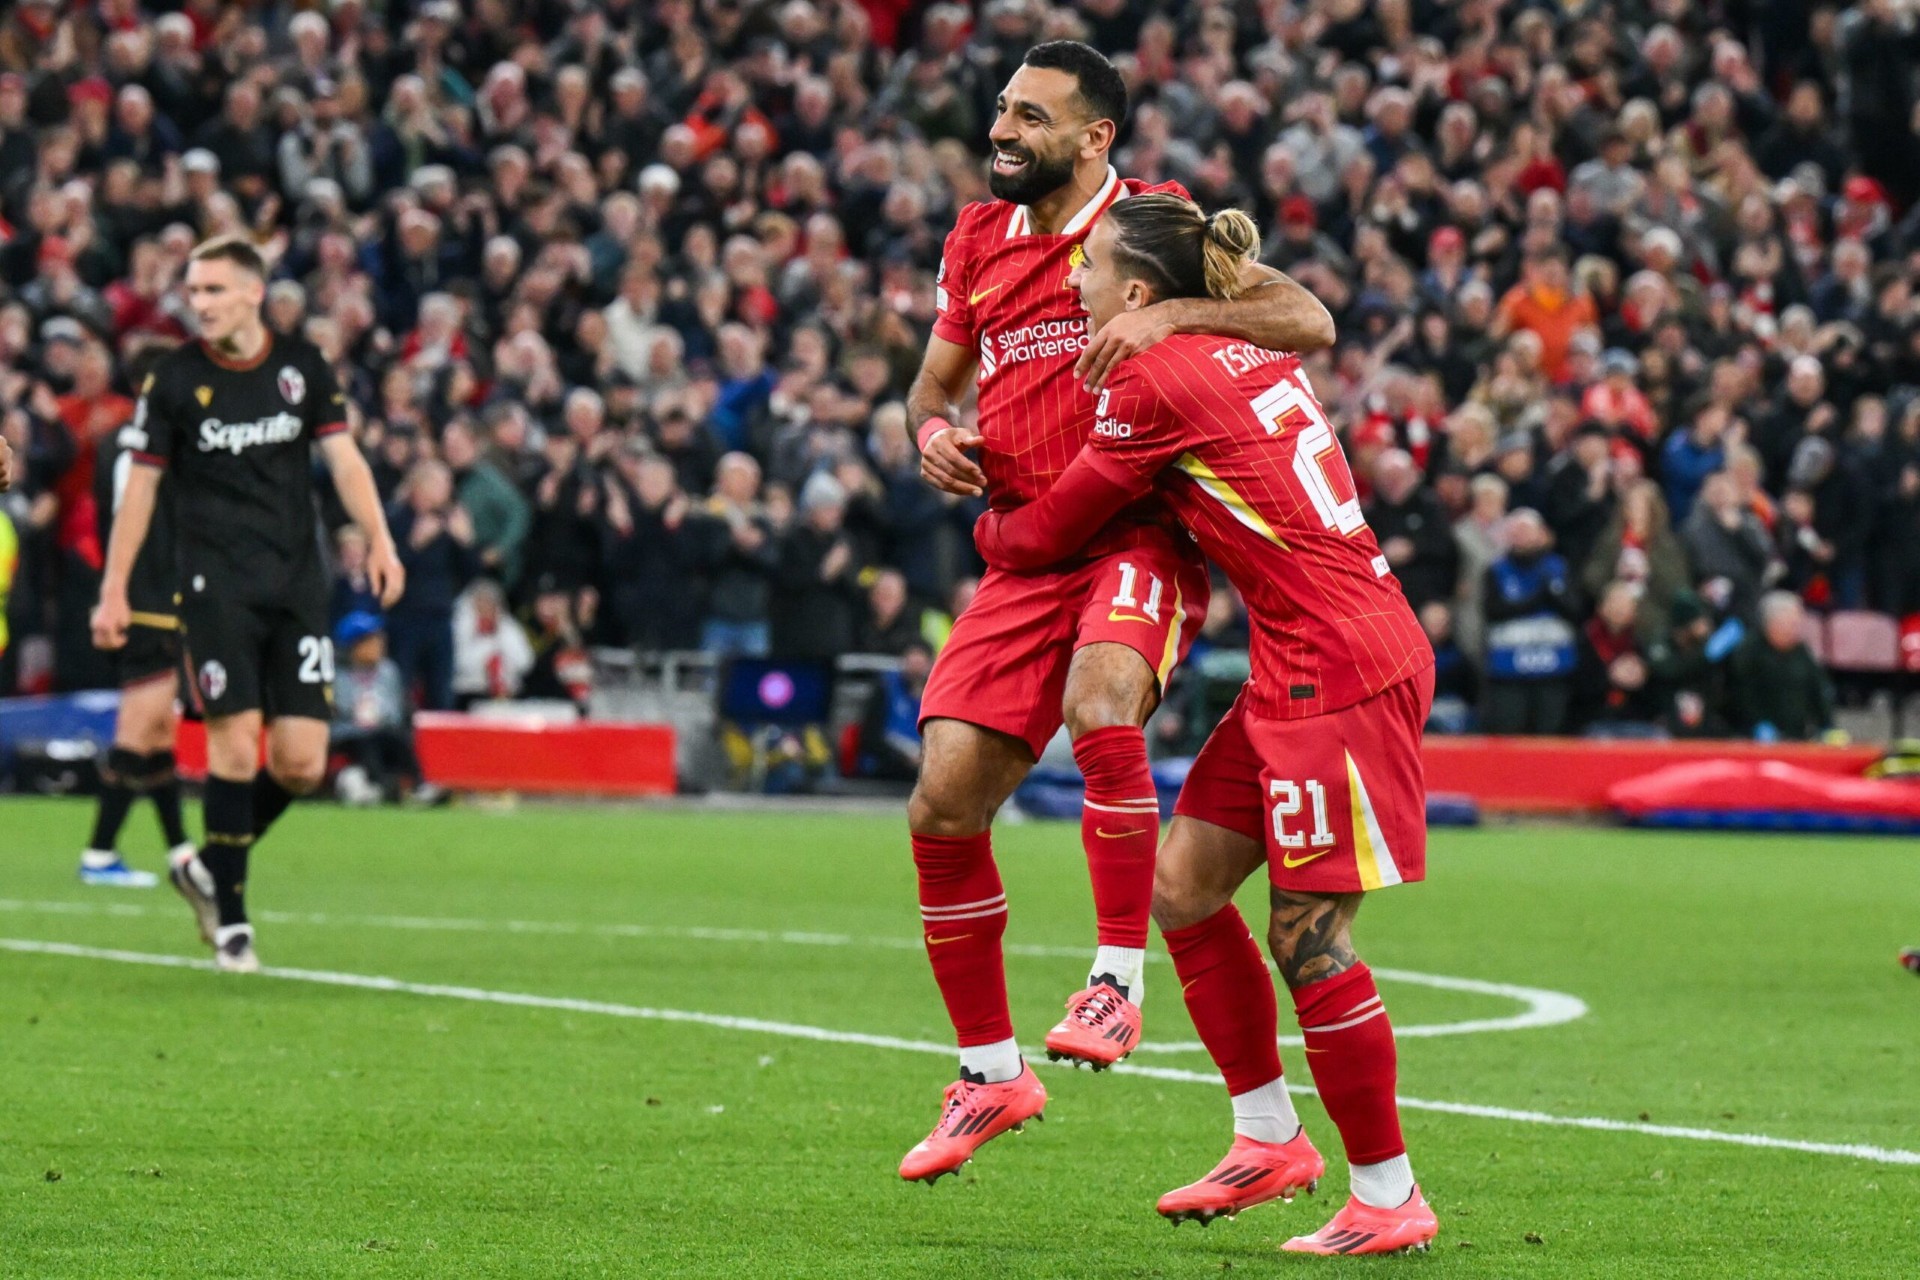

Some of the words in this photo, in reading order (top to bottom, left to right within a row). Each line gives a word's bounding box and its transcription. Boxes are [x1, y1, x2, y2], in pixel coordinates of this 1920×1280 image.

[198, 411, 303, 456] Saputo
[1111, 562, 1163, 626] 11
[298, 635, 335, 684] 20
[1269, 779, 1336, 848] 21
